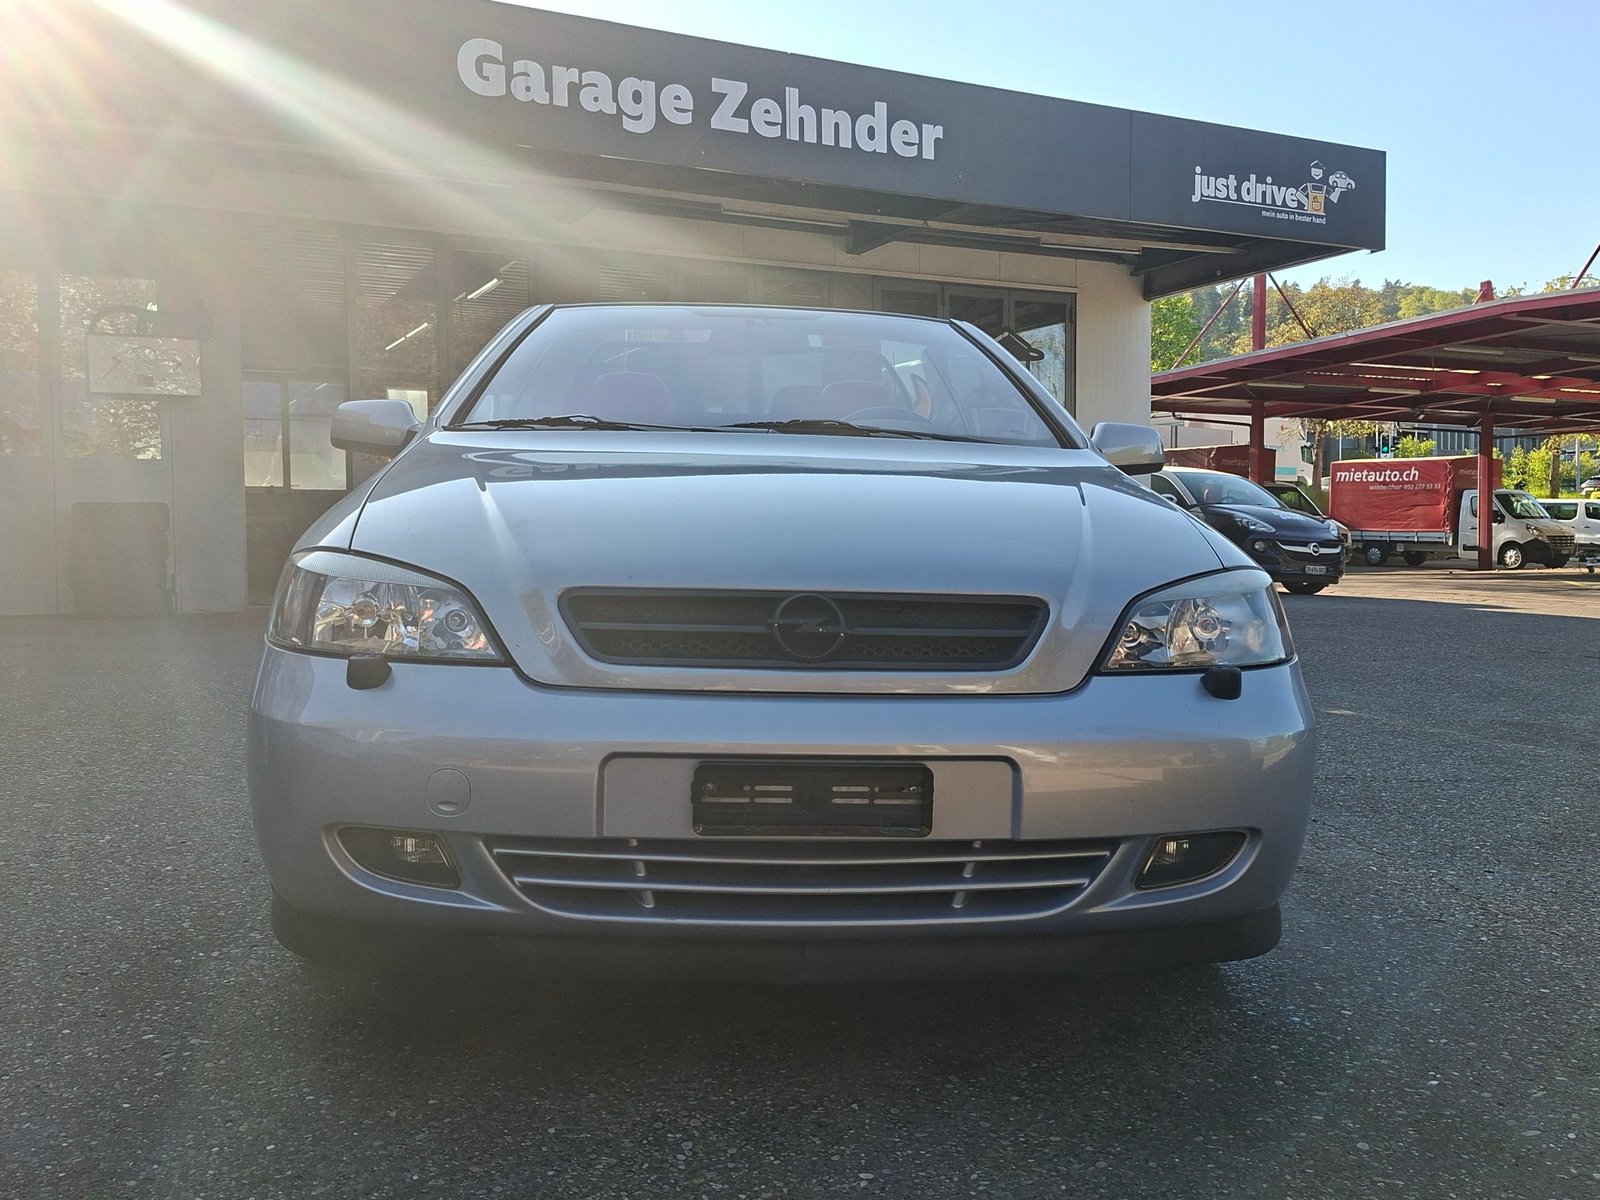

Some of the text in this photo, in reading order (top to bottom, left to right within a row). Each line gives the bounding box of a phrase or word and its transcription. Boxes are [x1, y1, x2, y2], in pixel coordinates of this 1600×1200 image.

[457, 38, 943, 160] Garage Zehnder
[1191, 165, 1298, 208] just drive
[1261, 210, 1276, 218] mein
[1276, 212, 1289, 220] auto
[1289, 212, 1295, 220] in
[1312, 215, 1326, 225] hand
[1335, 466, 1419, 482] mietauto.ch
